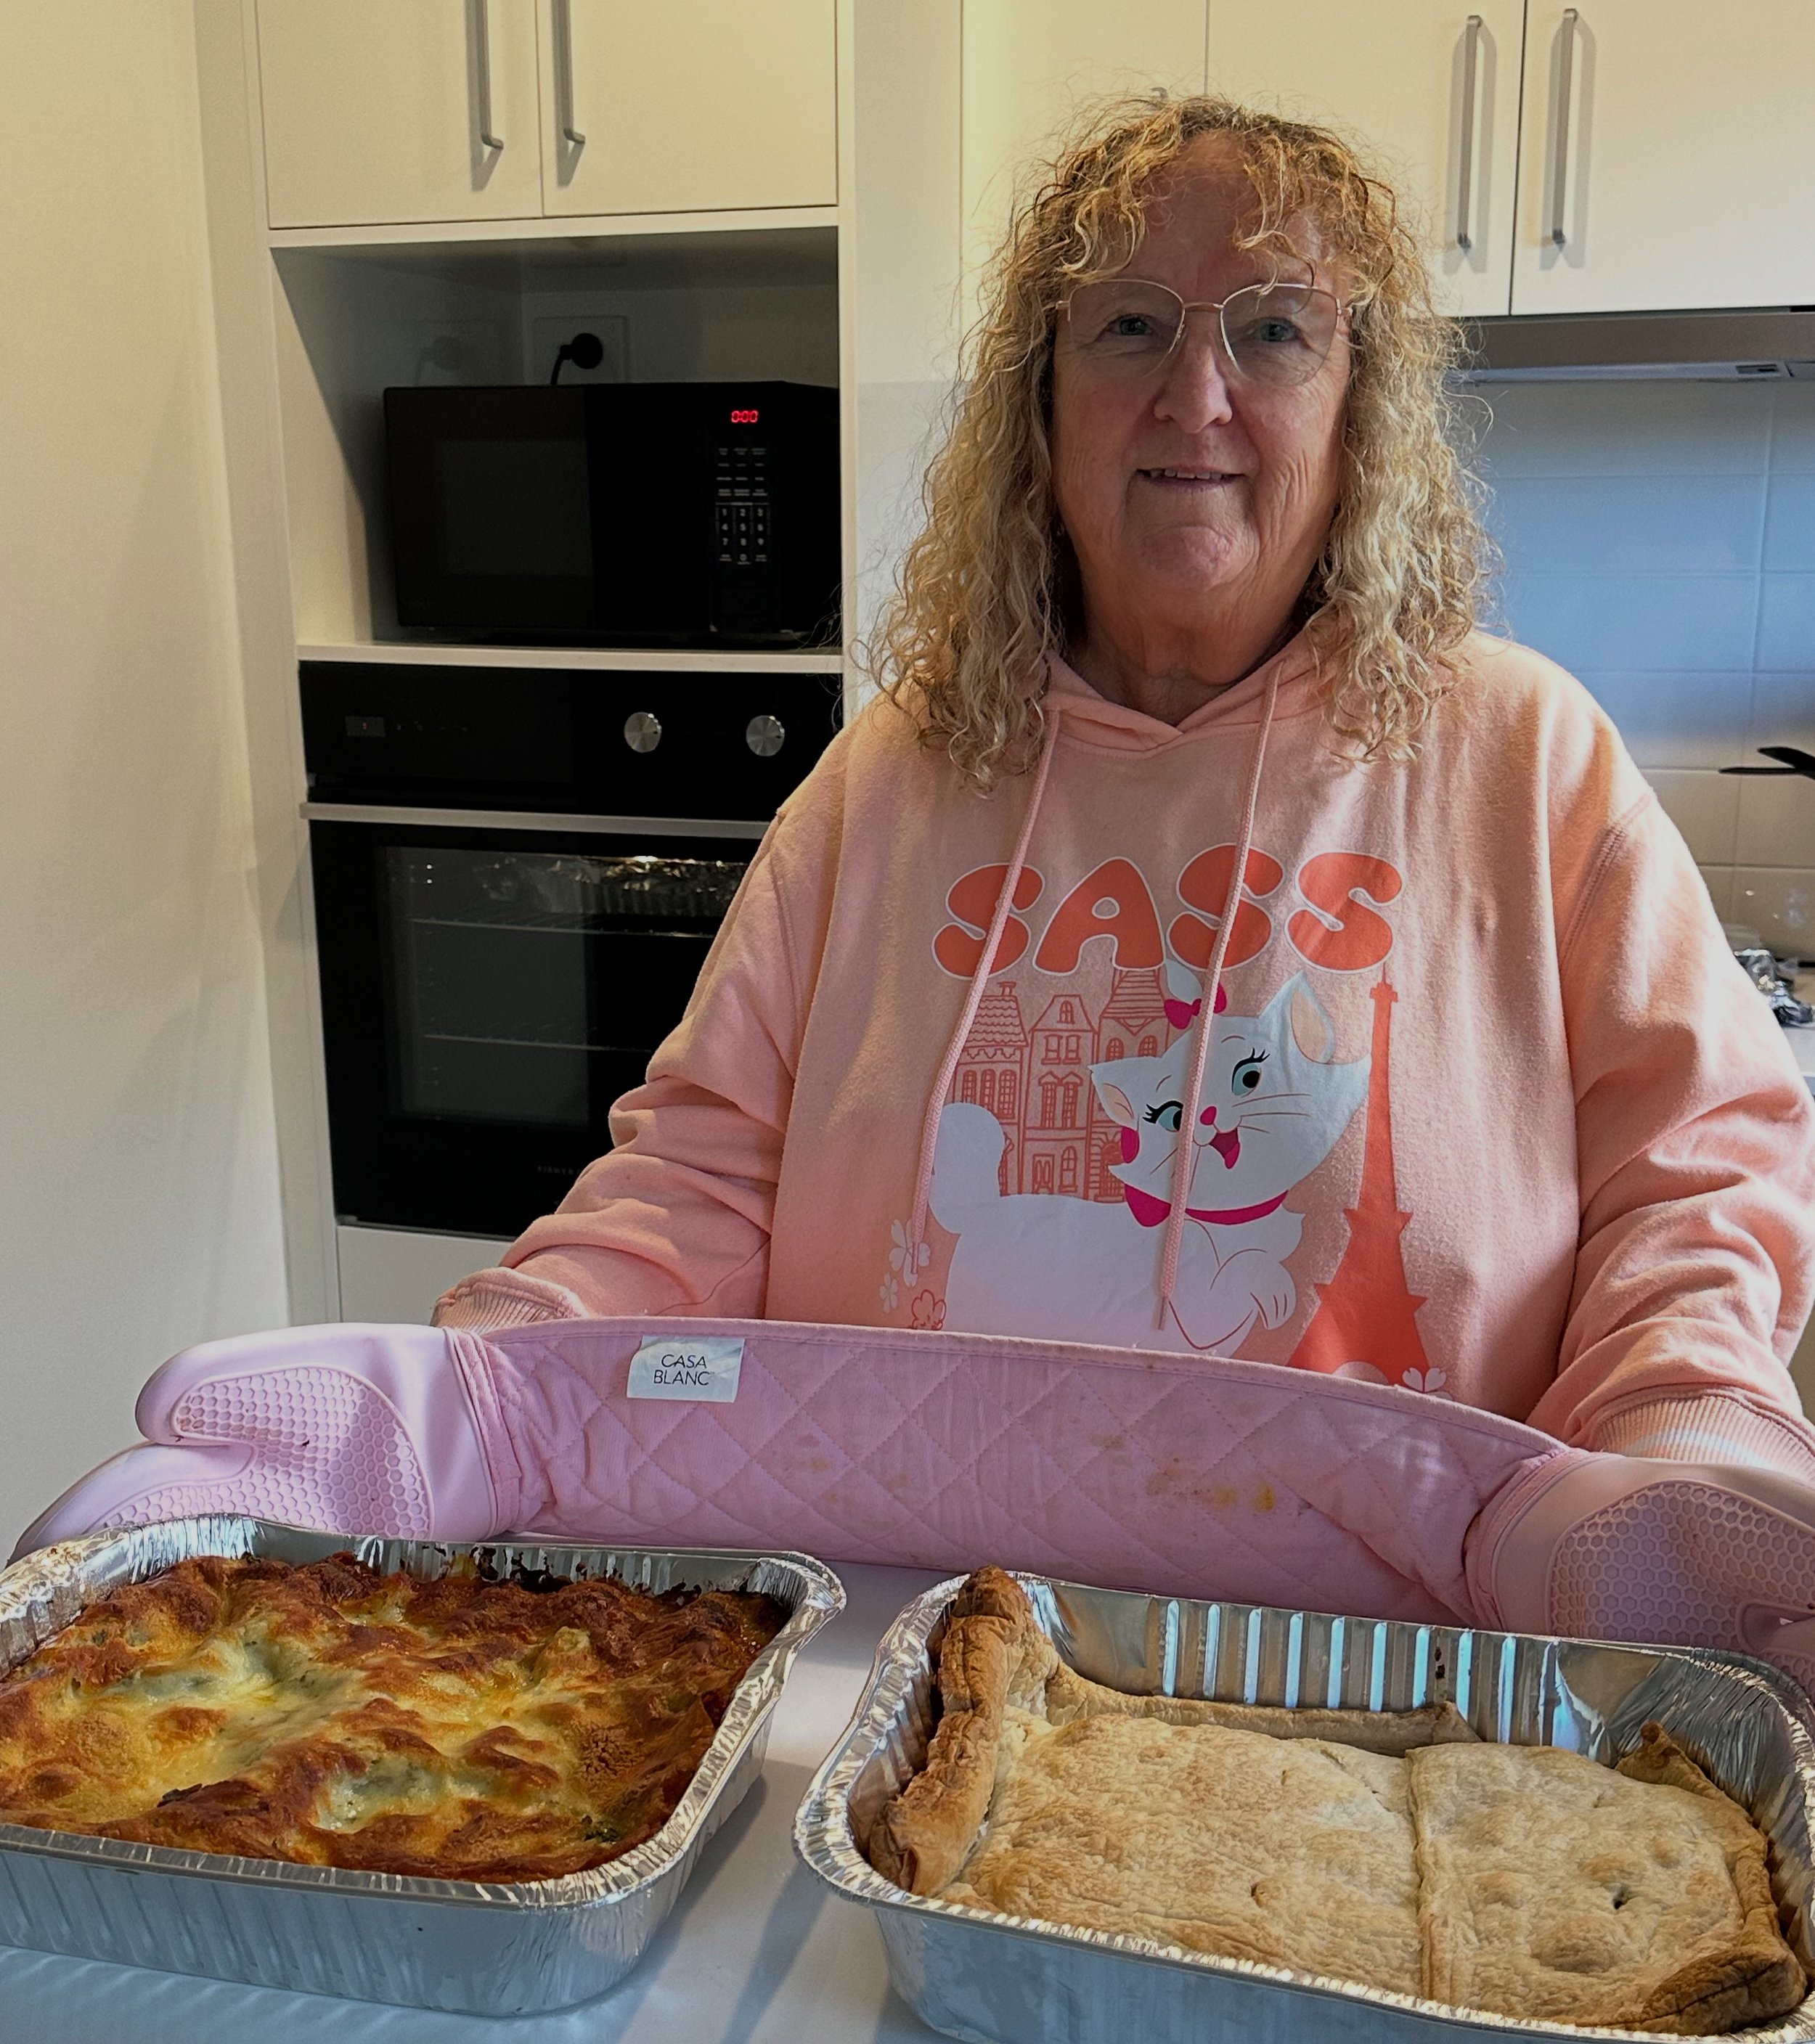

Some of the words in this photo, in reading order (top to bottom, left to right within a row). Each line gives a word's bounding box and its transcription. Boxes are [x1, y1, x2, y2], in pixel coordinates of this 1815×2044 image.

[931, 843, 1404, 981] SASS
[661, 1354, 707, 1369] CASA
[653, 1370, 710, 1386] BLANC
